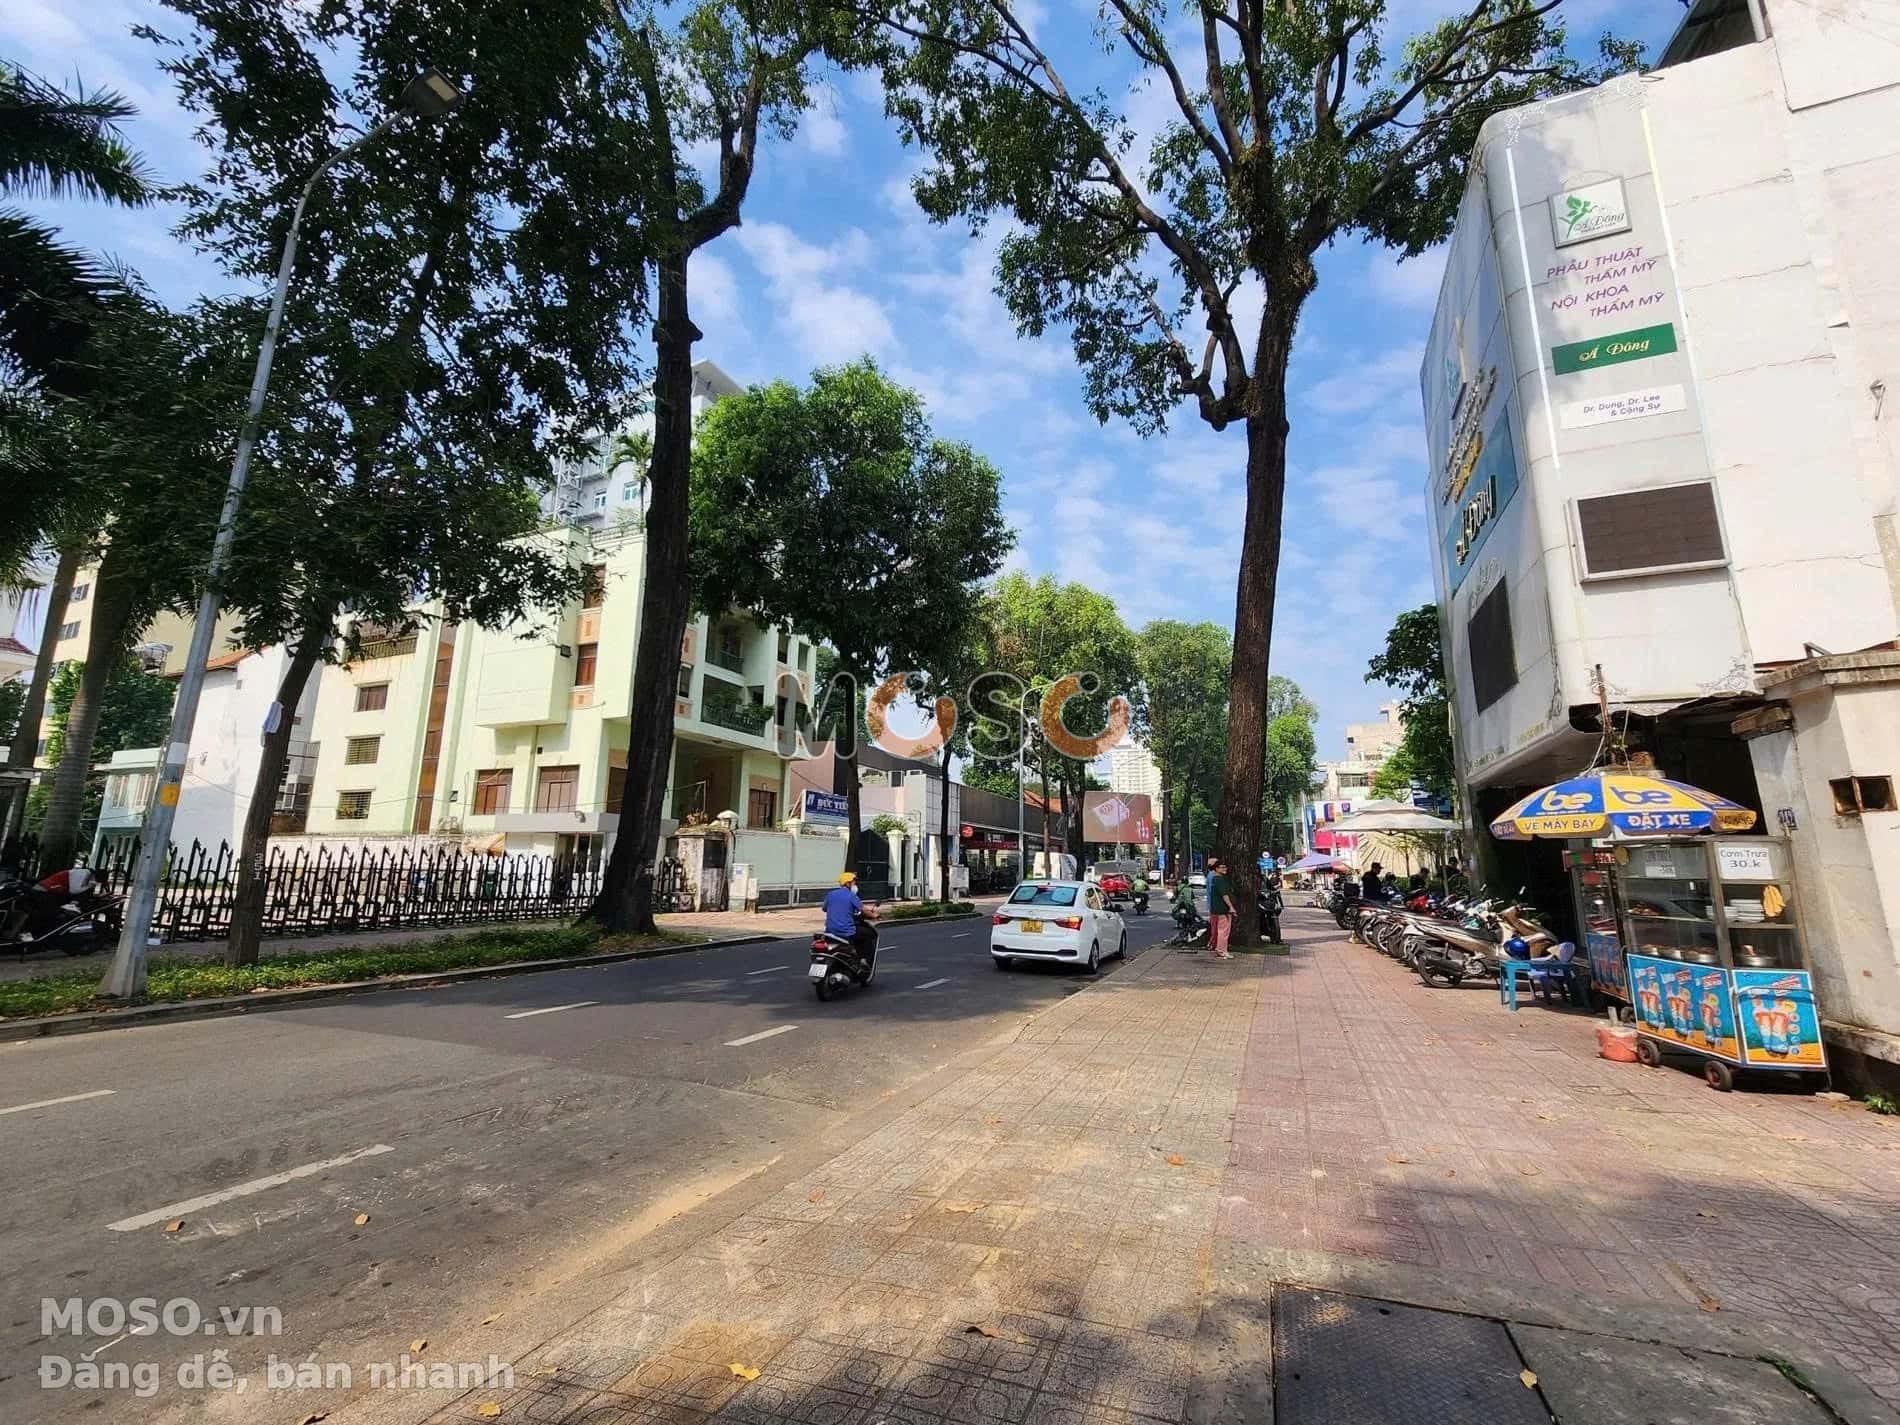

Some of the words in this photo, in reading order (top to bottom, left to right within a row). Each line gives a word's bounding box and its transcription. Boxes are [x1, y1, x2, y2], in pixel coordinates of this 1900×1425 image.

[1586, 284, 1629, 302] KHOA
[1541, 791, 1592, 811] be
[1609, 786, 1672, 804] be
[1543, 818, 1568, 829] MÁY
[1572, 819, 1596, 829] BAY
[1668, 814, 1691, 825] XE
